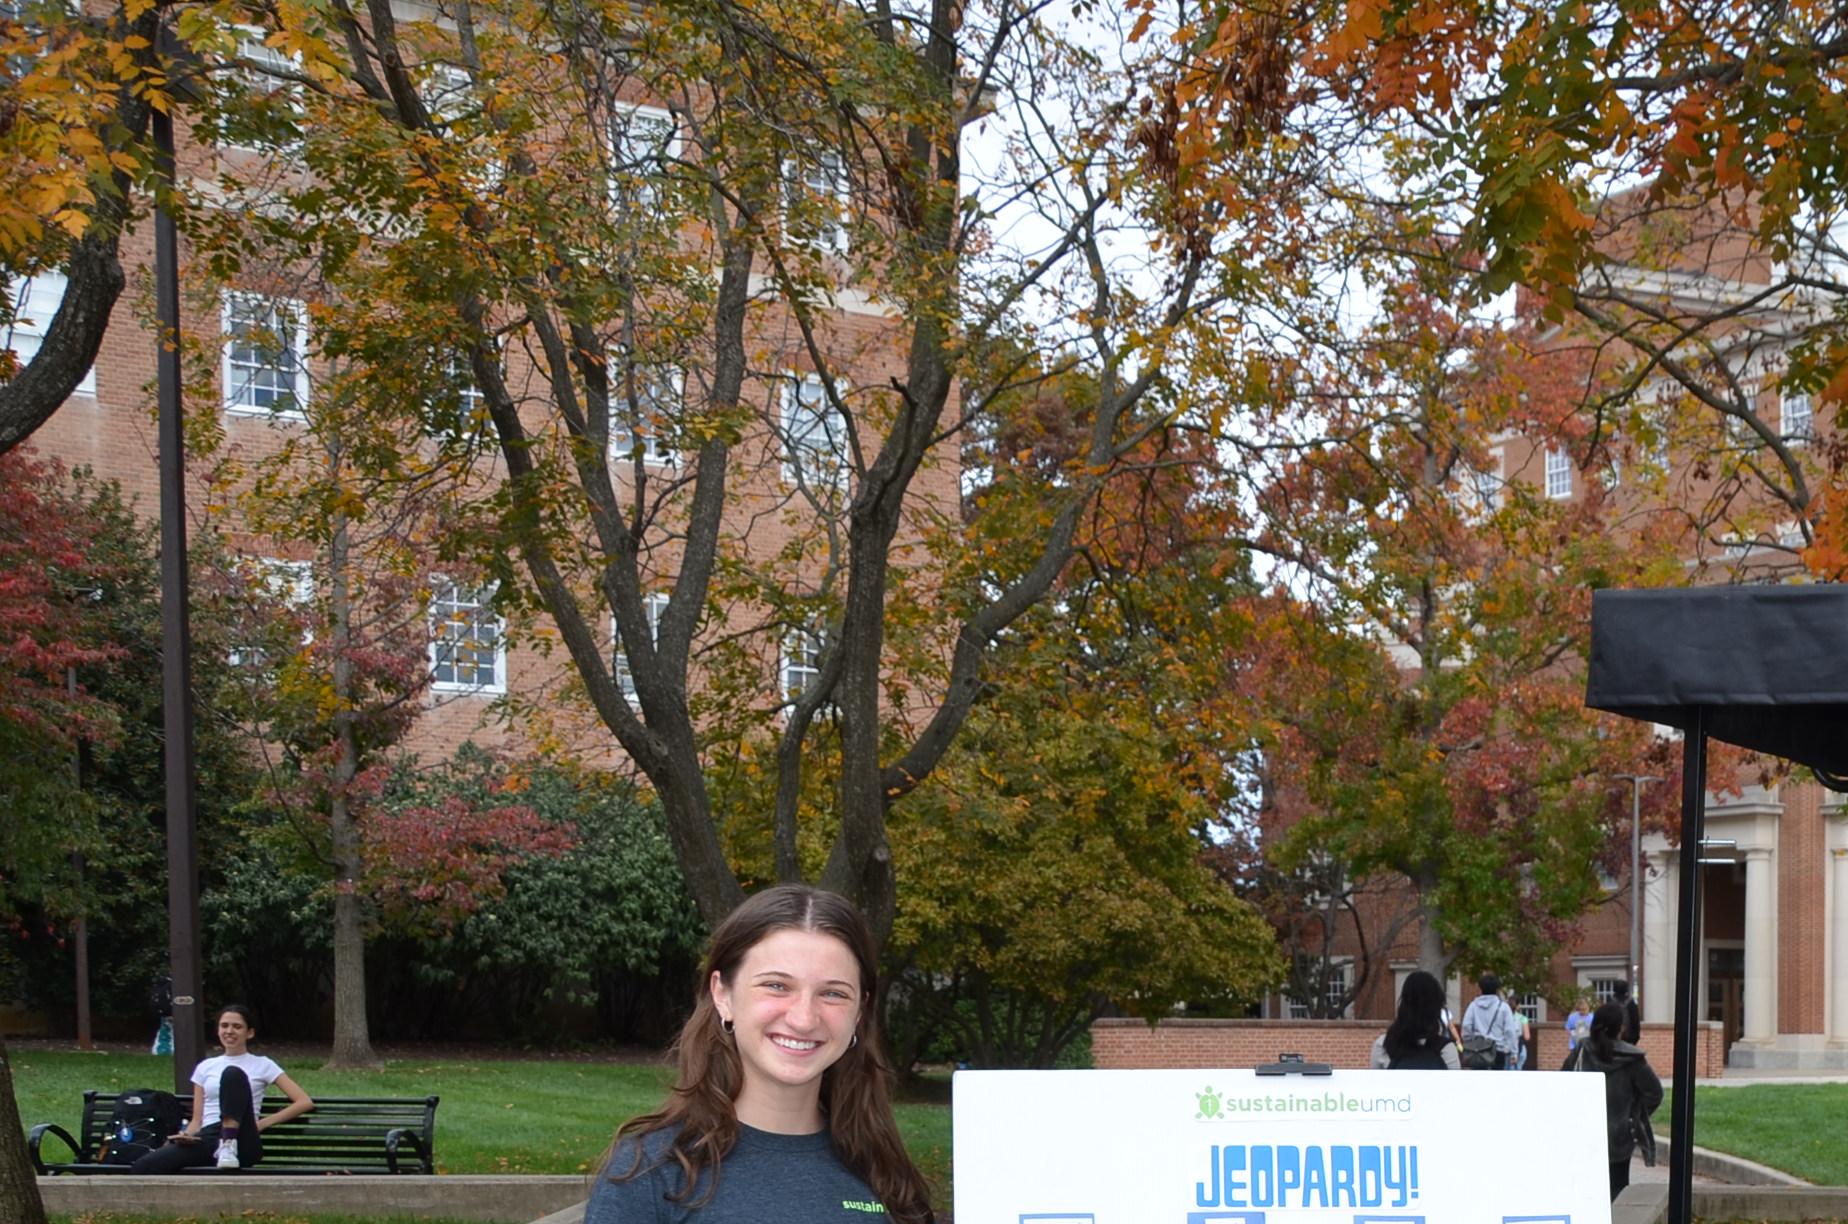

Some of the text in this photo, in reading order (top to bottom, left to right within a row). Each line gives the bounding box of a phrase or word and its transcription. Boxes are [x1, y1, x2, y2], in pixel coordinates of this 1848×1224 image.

[1227, 1092, 1411, 1113] sustainableumd
[1196, 1145, 1419, 1208] JEOPARDY!
[842, 1200, 885, 1213] sustain
